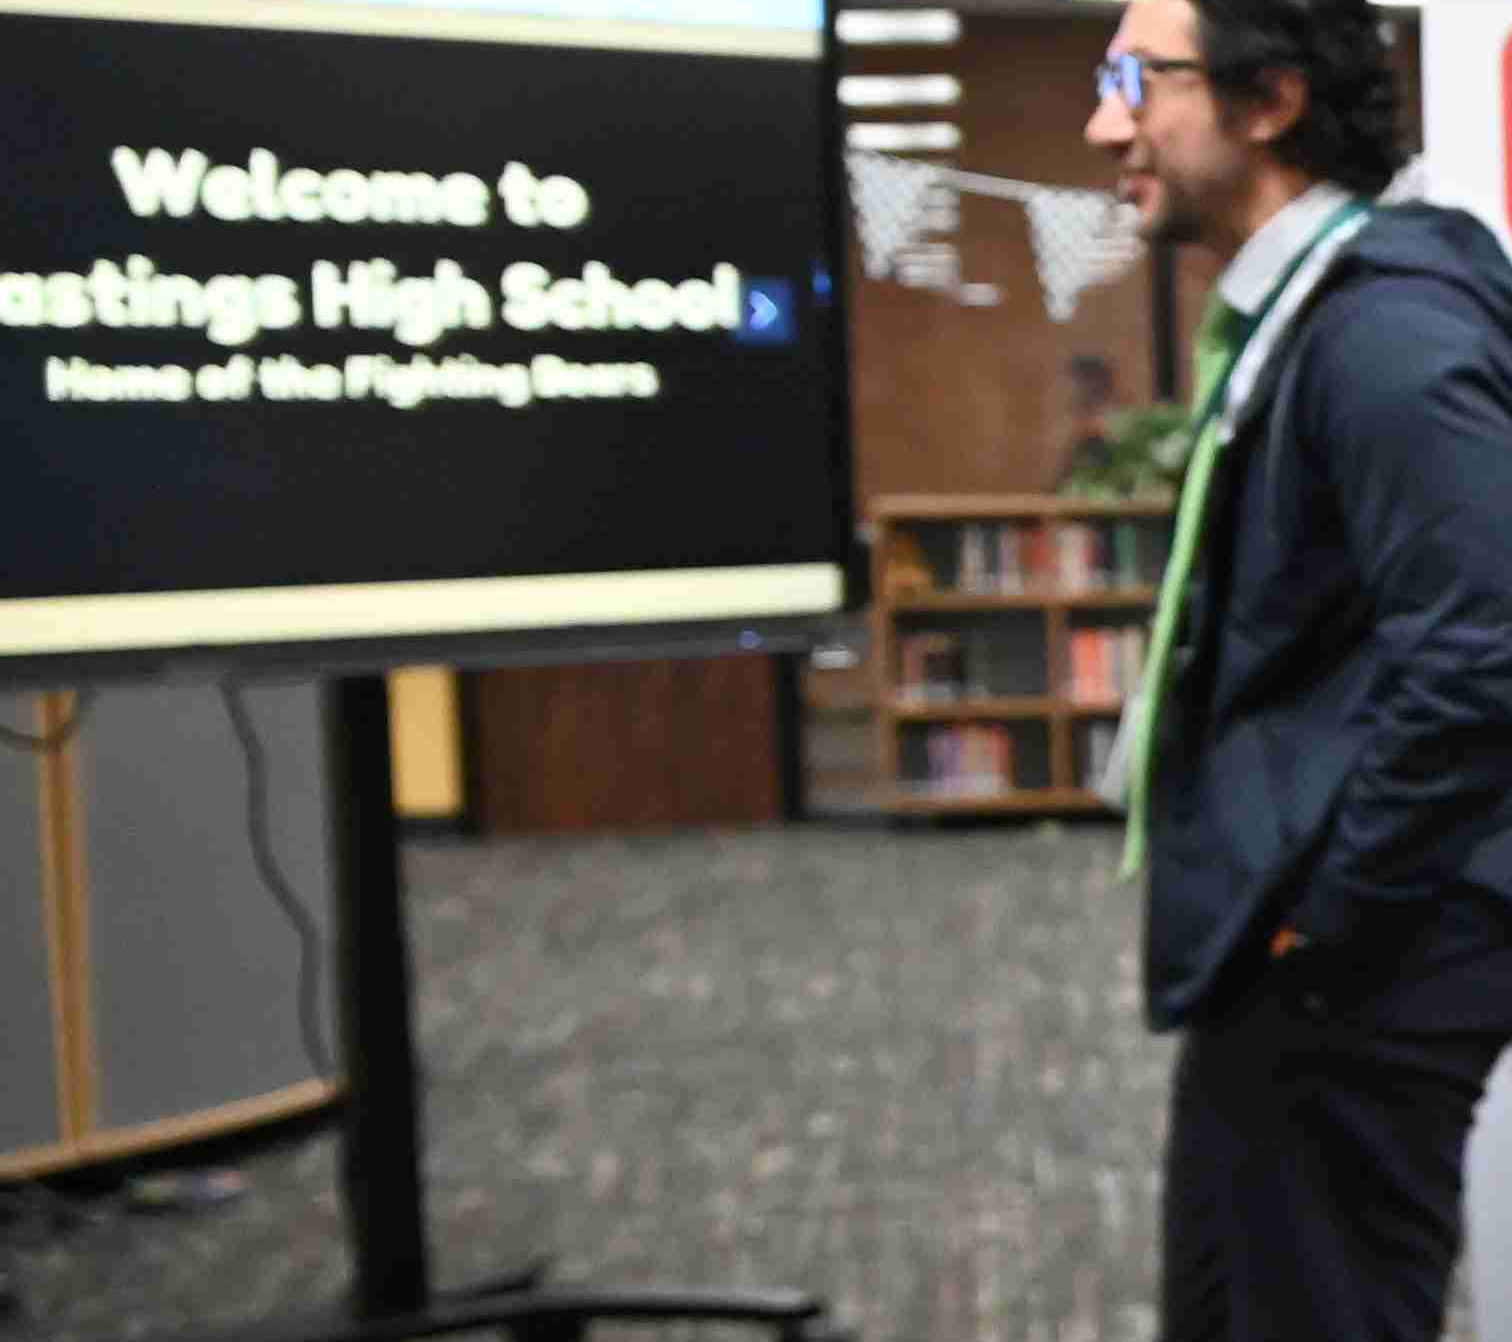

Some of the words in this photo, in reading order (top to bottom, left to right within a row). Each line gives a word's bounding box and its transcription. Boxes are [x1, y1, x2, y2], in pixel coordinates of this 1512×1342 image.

[112, 145, 490, 226] Welcome
[499, 160, 590, 228] to
[312, 258, 492, 346] High
[501, 261, 742, 331] School
[46, 355, 192, 402] Home
[195, 354, 254, 402] of
[258, 355, 343, 401] the
[345, 354, 531, 408] Fighting
